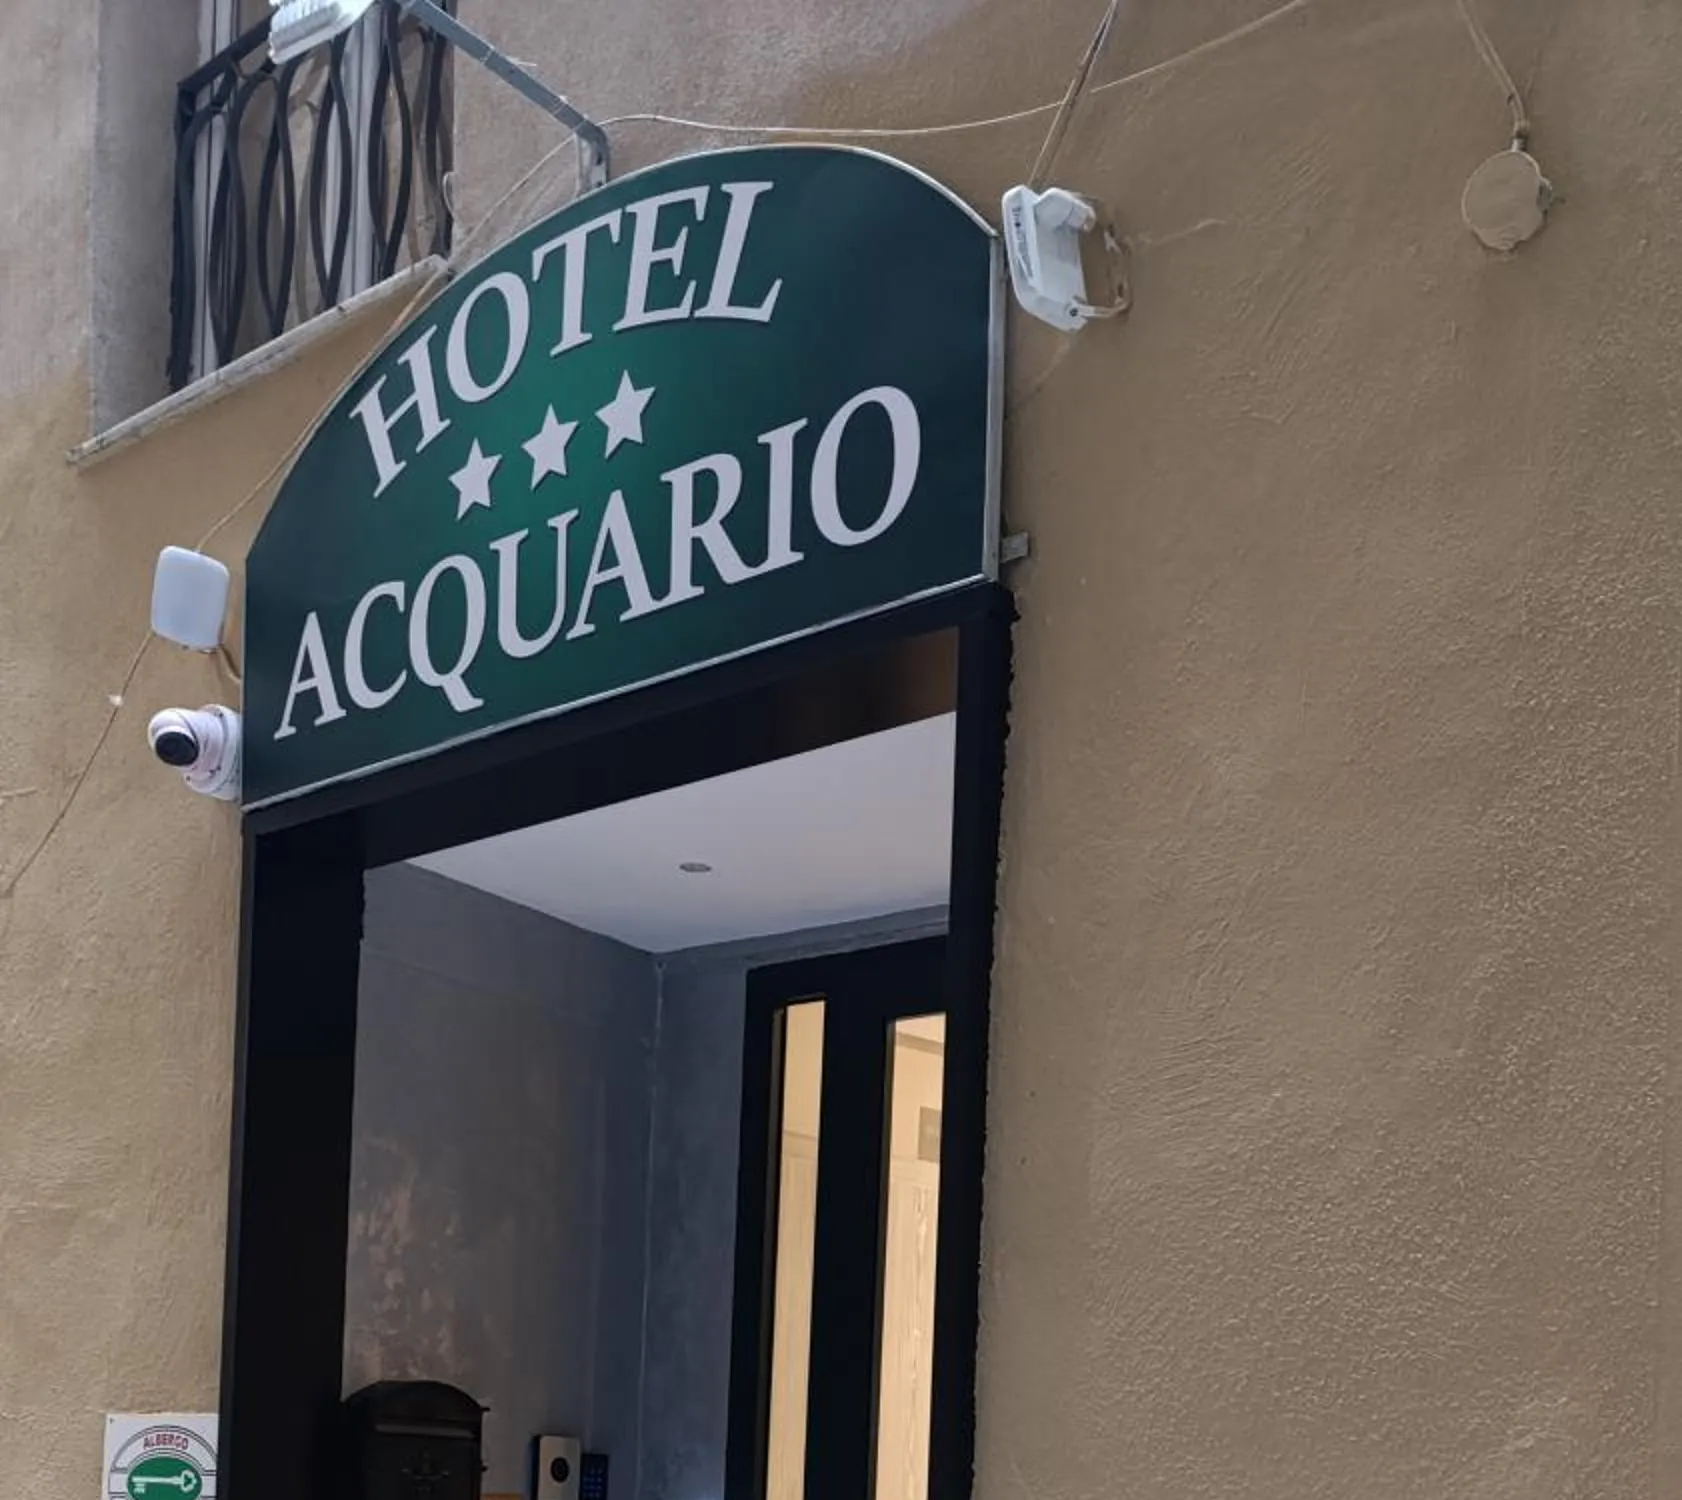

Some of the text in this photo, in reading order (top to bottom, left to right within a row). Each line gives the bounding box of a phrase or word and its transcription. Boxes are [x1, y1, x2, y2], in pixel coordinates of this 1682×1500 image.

[349, 180, 783, 498] HOTEL
[274, 385, 922, 740] ACQUARIO
[143, 1433, 189, 1450] ALBERGO
